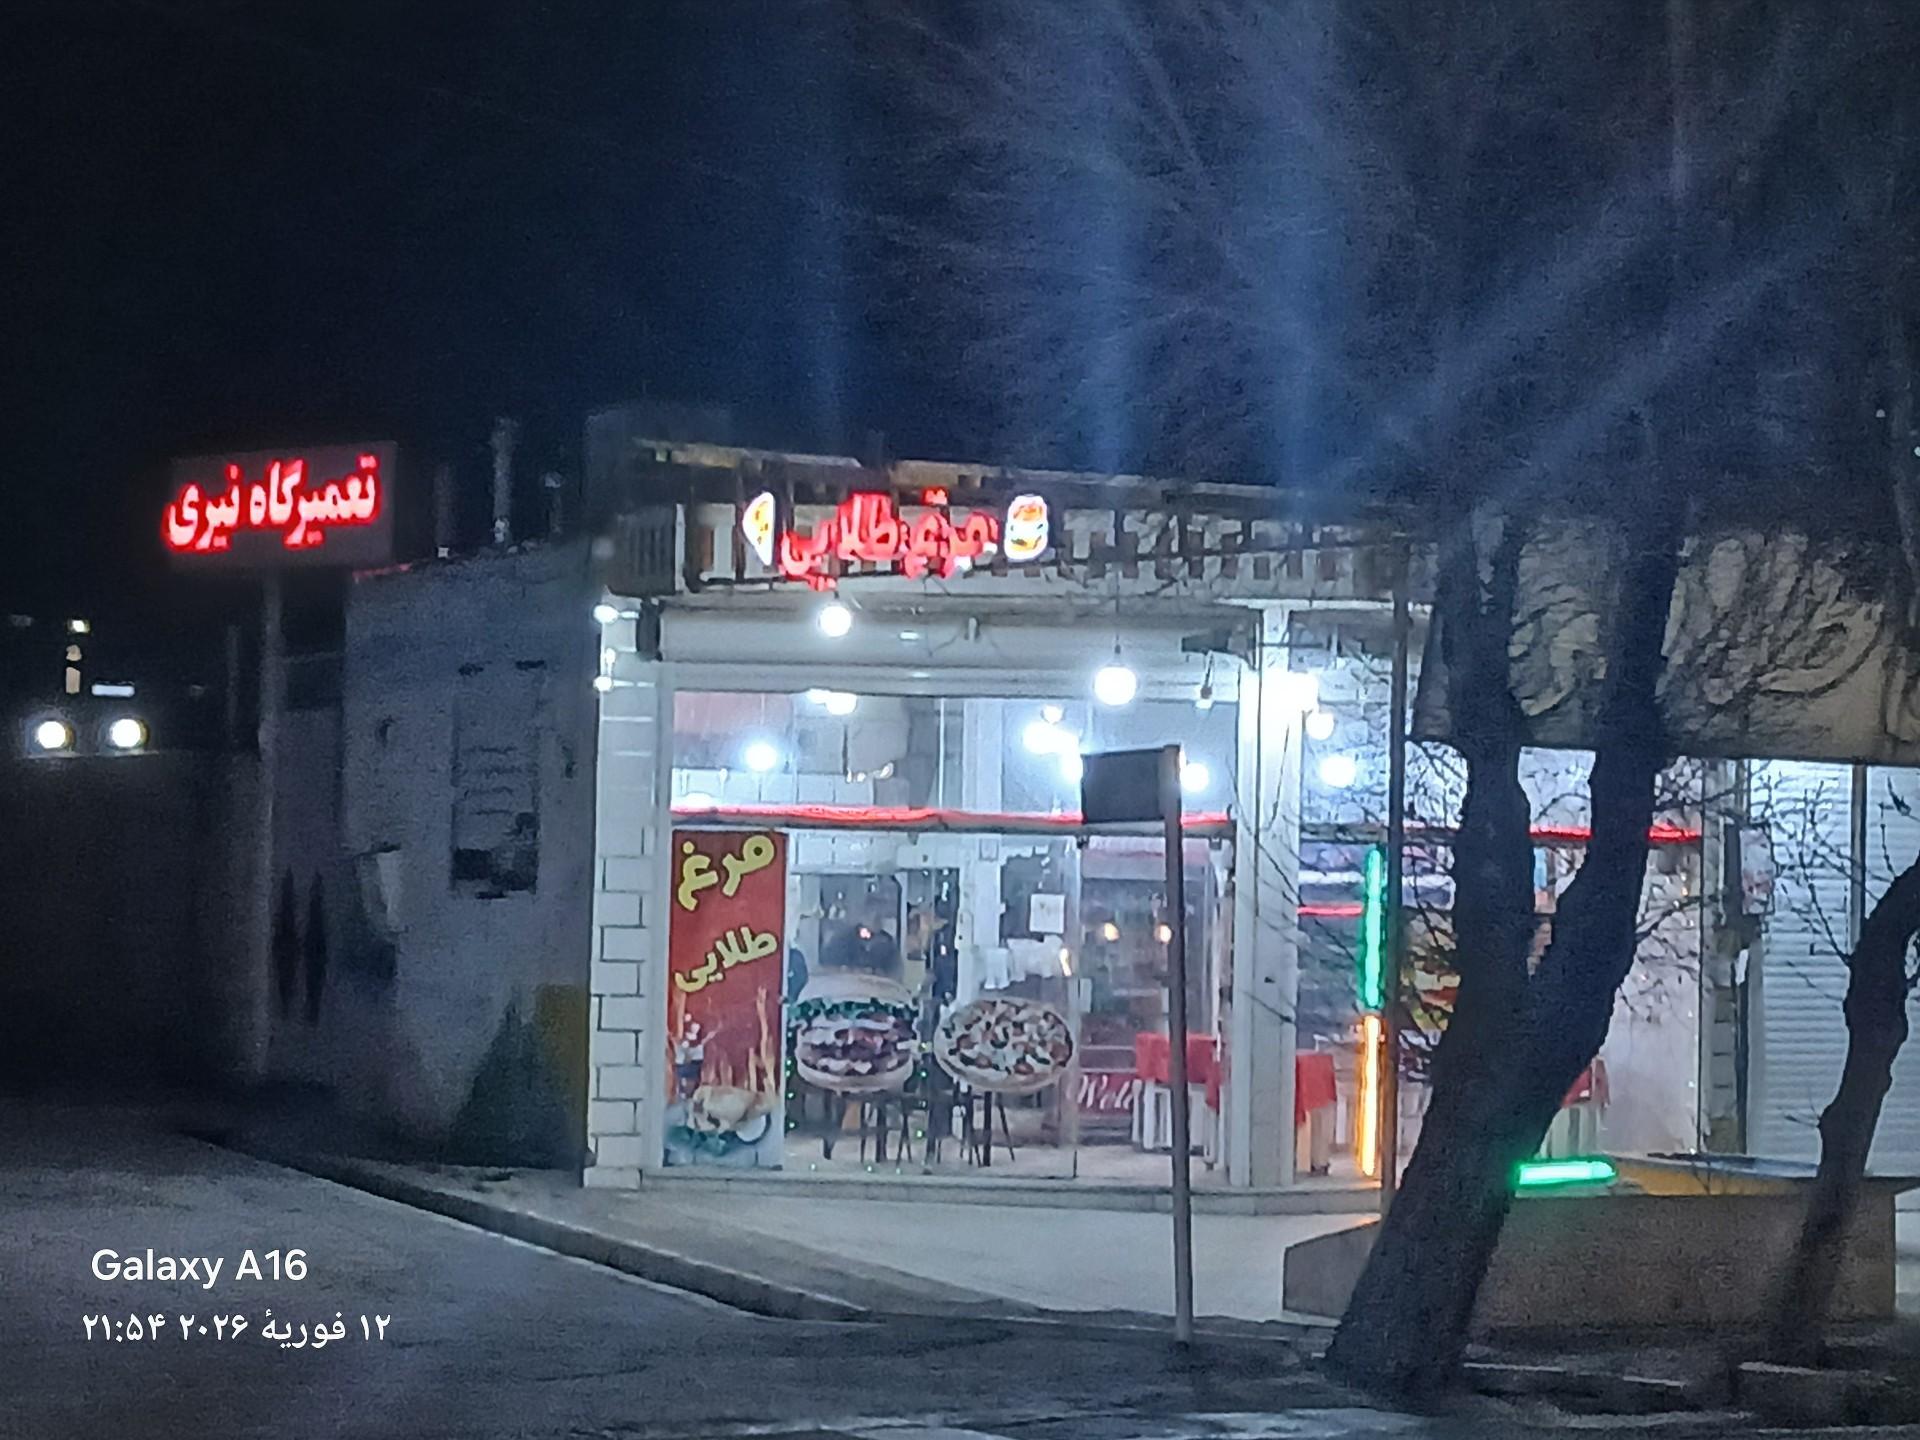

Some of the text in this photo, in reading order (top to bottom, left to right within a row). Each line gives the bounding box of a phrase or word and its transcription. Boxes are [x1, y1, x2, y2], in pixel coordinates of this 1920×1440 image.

[249, 454, 377, 547] تعمیرگاه
[778, 487, 901, 592] طلایی
[677, 834, 776, 912] مرغ
[674, 925, 778, 993] طلایی
